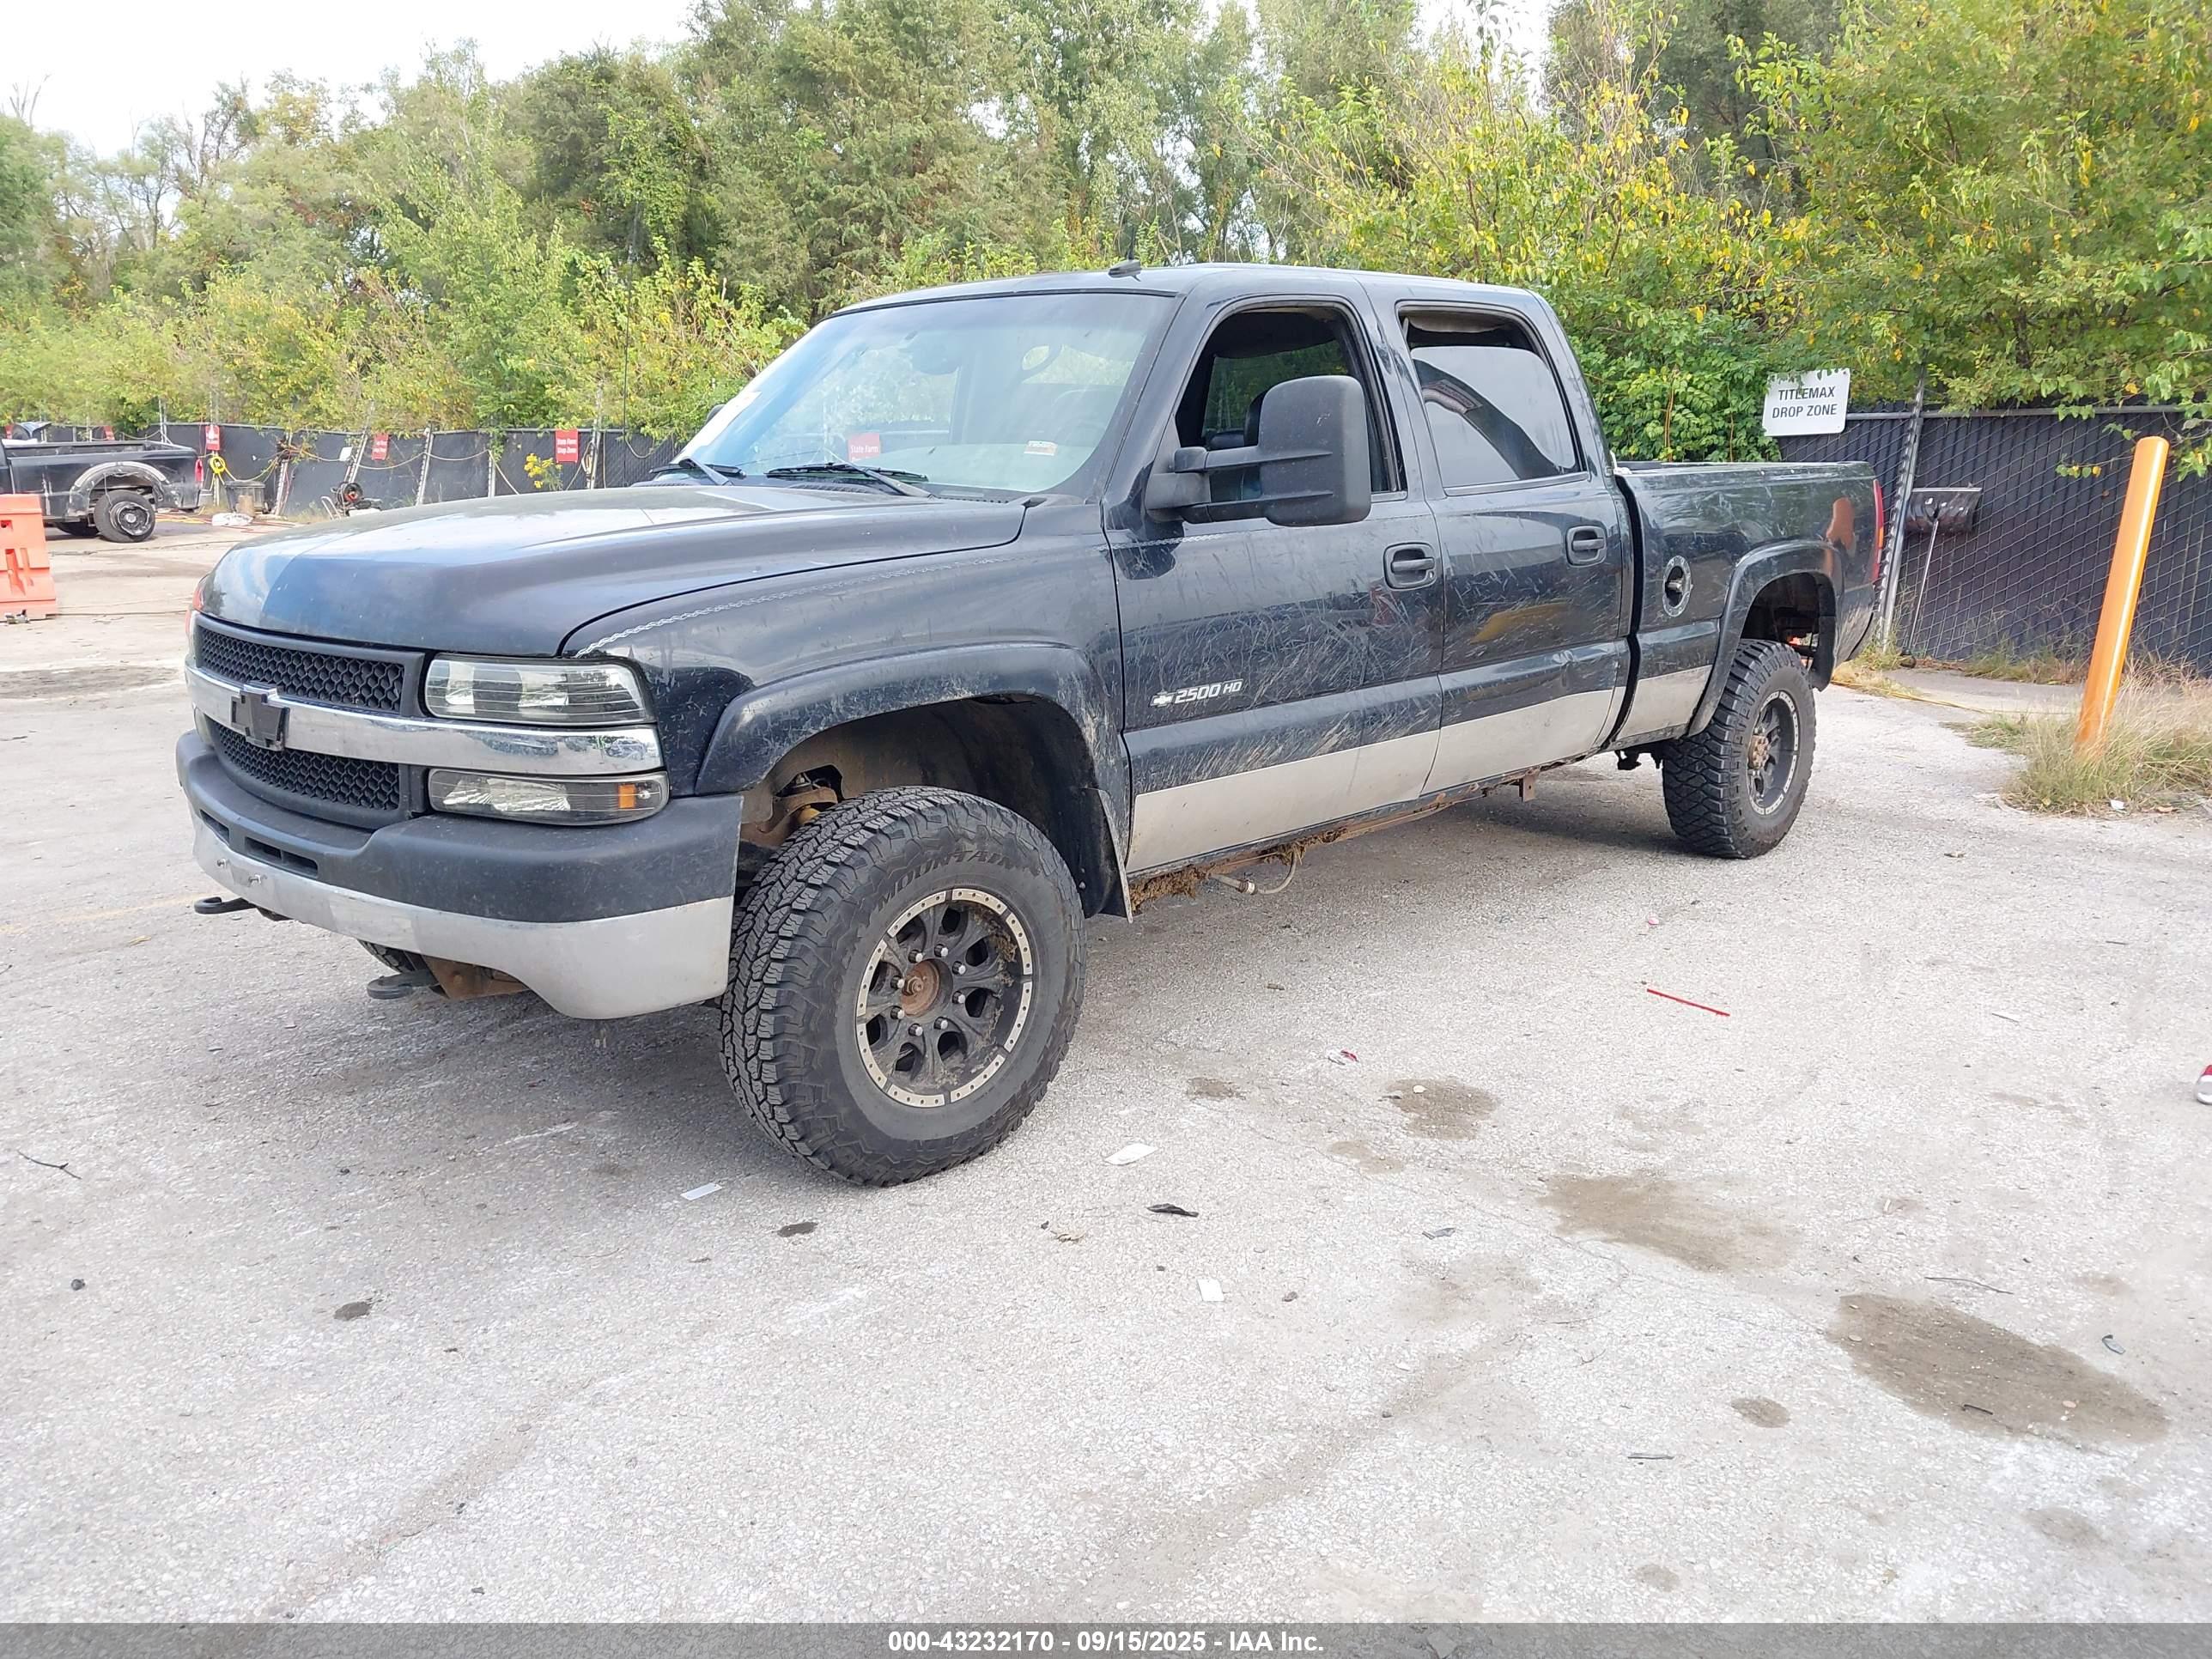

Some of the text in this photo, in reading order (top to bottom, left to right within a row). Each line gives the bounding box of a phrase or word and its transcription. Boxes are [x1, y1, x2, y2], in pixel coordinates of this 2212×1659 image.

[1778, 386, 1836, 401] TITLEMAX
[1771, 404, 1838, 419] DROP ZONE
[851, 445, 878, 453] State Farm
[1175, 681, 1242, 704] 2500 HD
[882, 849, 1015, 907] MOUNTAIN
